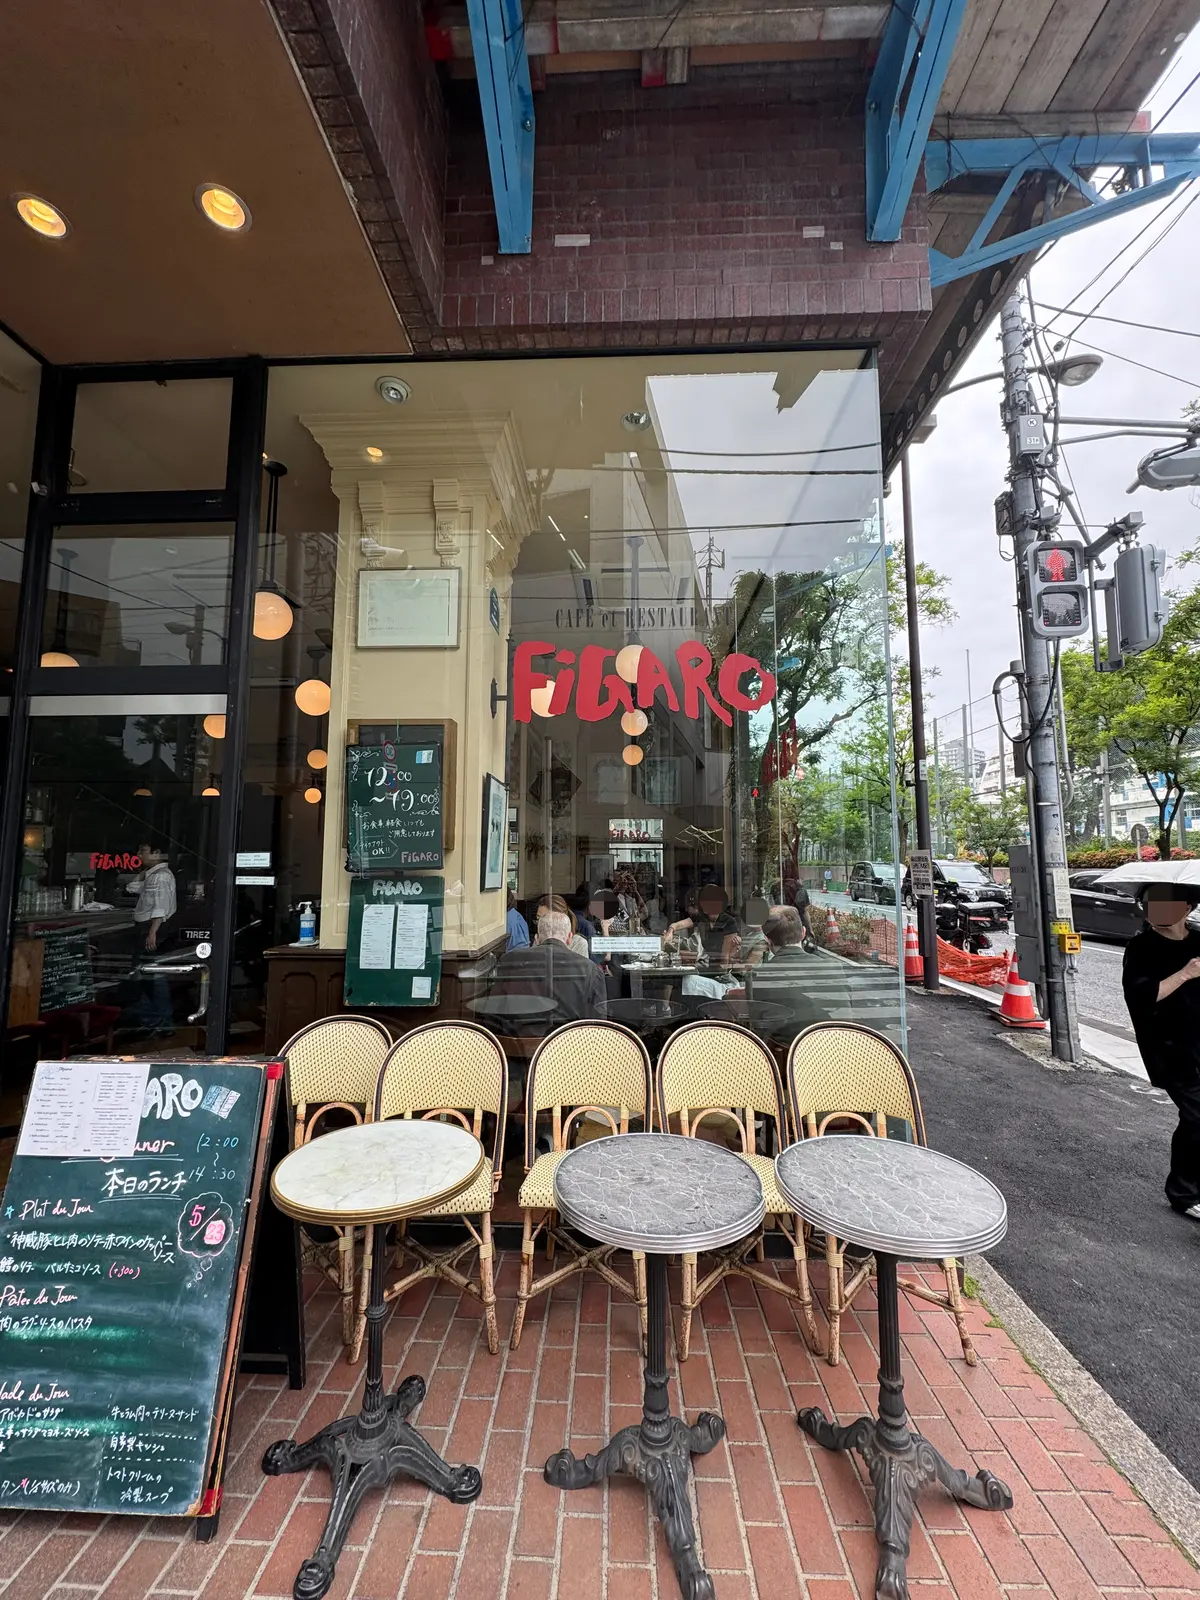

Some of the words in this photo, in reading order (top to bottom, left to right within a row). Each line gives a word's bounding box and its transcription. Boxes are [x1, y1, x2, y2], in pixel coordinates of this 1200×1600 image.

[602, 612, 617, 628] et
[364, 766, 412, 787] 12:00
[185, 930, 210, 939] TIREZ
[101, 1168, 187, 1197] 本日のランチ
[19, 1199, 51, 1220] Plat
[52, 1199, 67, 1214] du
[33, 1288, 48, 1305] du
[29, 1383, 43, 1401] du
[120, 1486, 174, 1504] 冷製スープ
